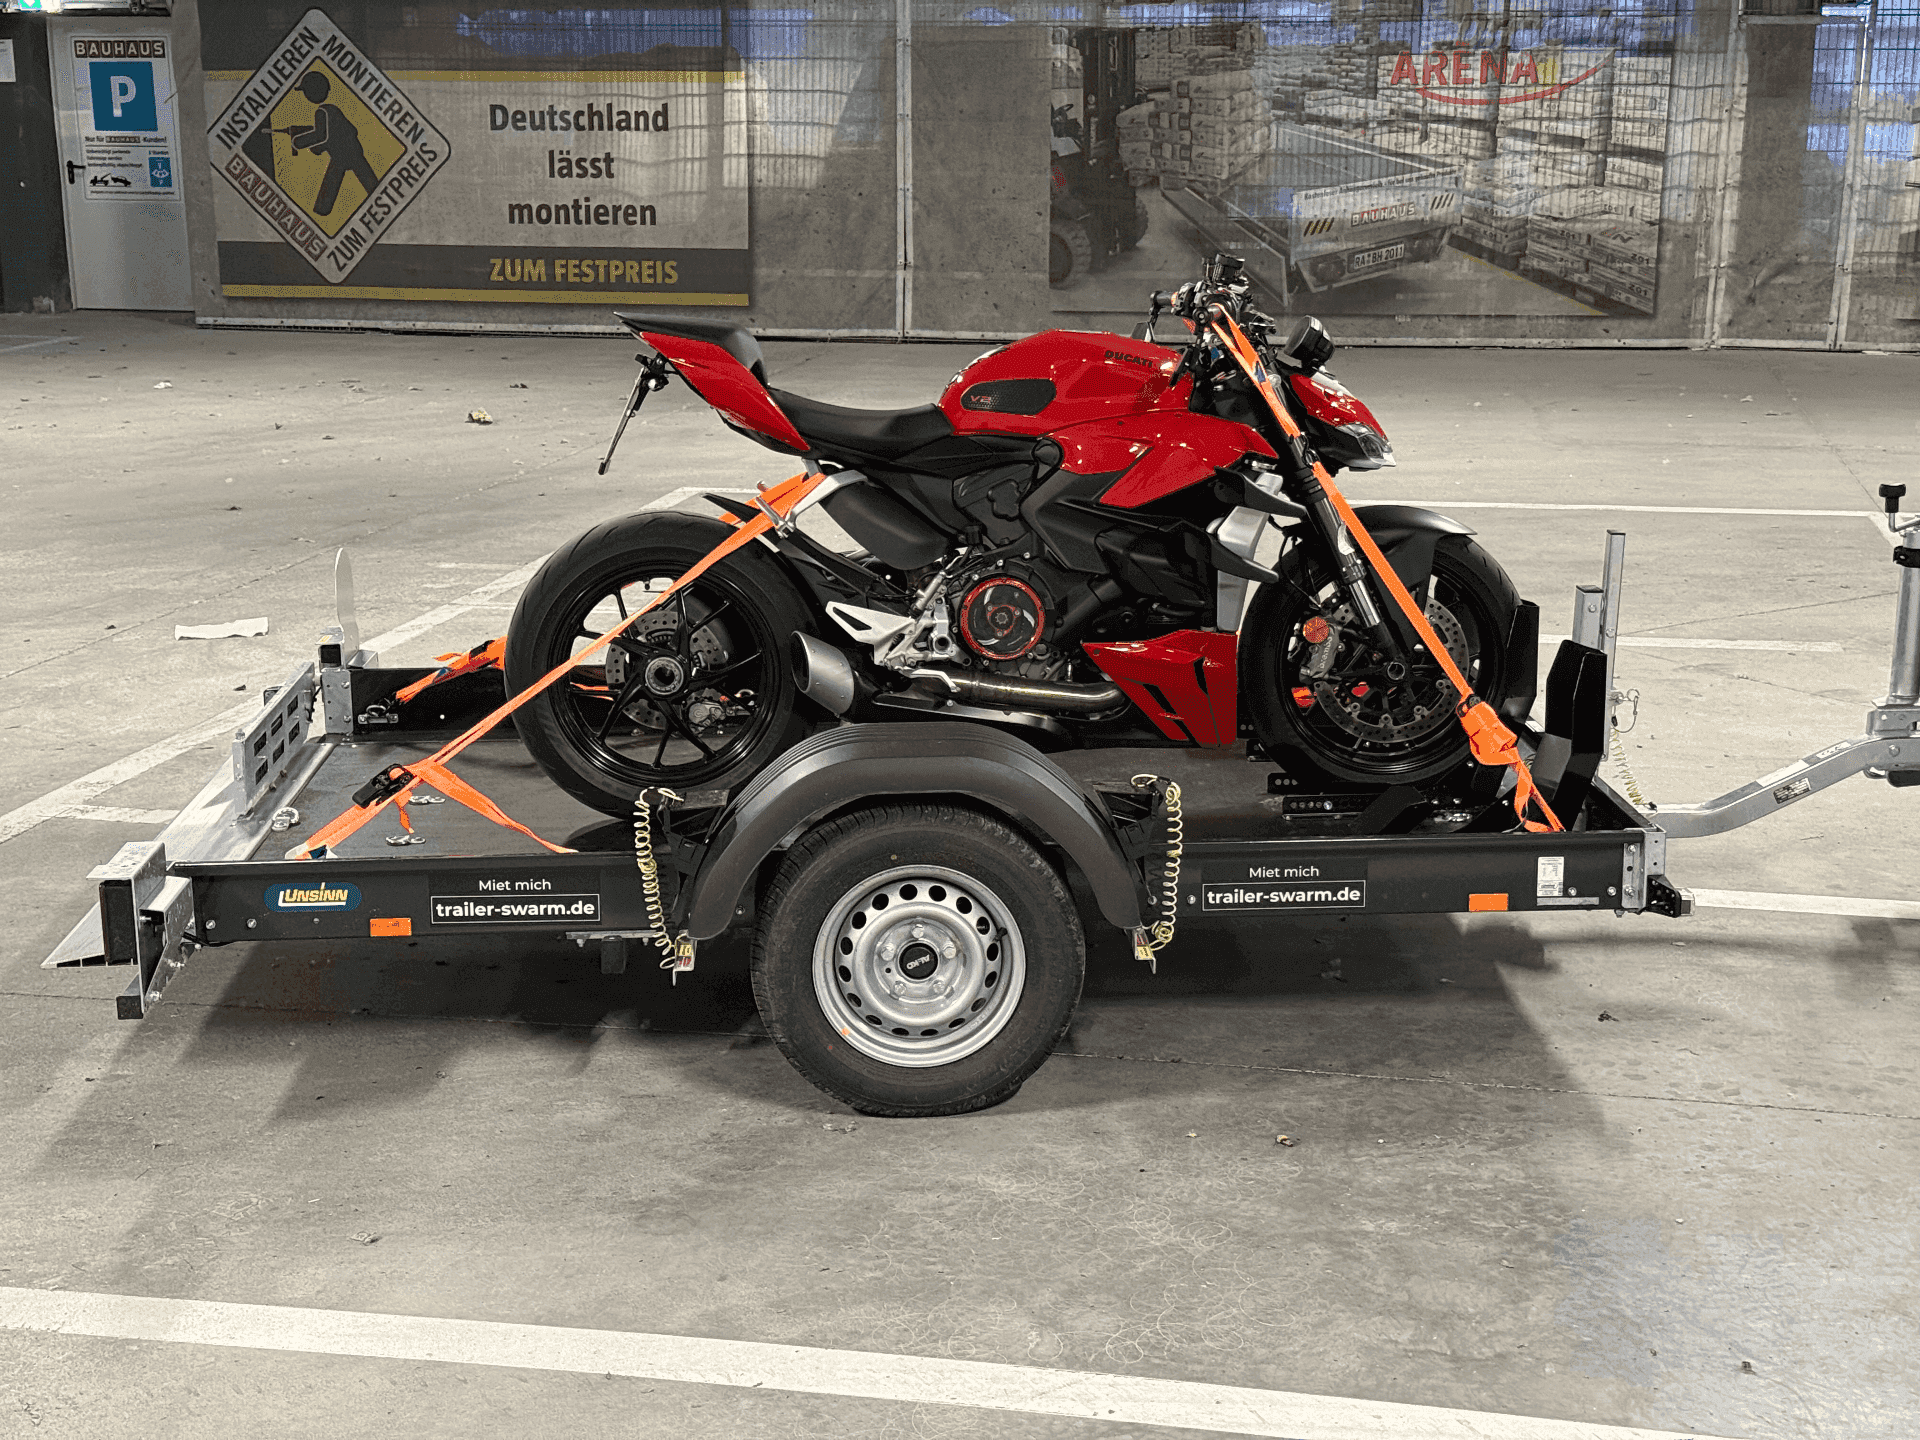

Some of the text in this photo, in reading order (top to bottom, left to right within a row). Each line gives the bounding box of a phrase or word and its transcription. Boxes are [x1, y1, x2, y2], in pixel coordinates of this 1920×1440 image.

[75, 41, 165, 57] BAUHAUS
[1390, 50, 1538, 85] ARENA
[110, 76, 136, 117] P
[216, 26, 320, 150] INSTALLIEREN
[321, 34, 425, 145] MONTIEREN
[489, 103, 669, 131] Deutschland
[548, 150, 615, 178] lässt
[226, 154, 327, 260] BAUHAUS
[327, 142, 438, 272] ZUM FESTPREIS
[508, 197, 657, 226] montieren
[1351, 203, 1415, 226] BAUHAUS
[489, 258, 678, 284] ZUM FESTPREIS
[1104, 350, 1153, 368] DUCATI
[479, 879, 551, 891] Miet mich
[1249, 866, 1320, 878] Miet mich
[436, 901, 595, 917] trailer-swarm.de
[1207, 887, 1361, 904] trailer-swarm.de
